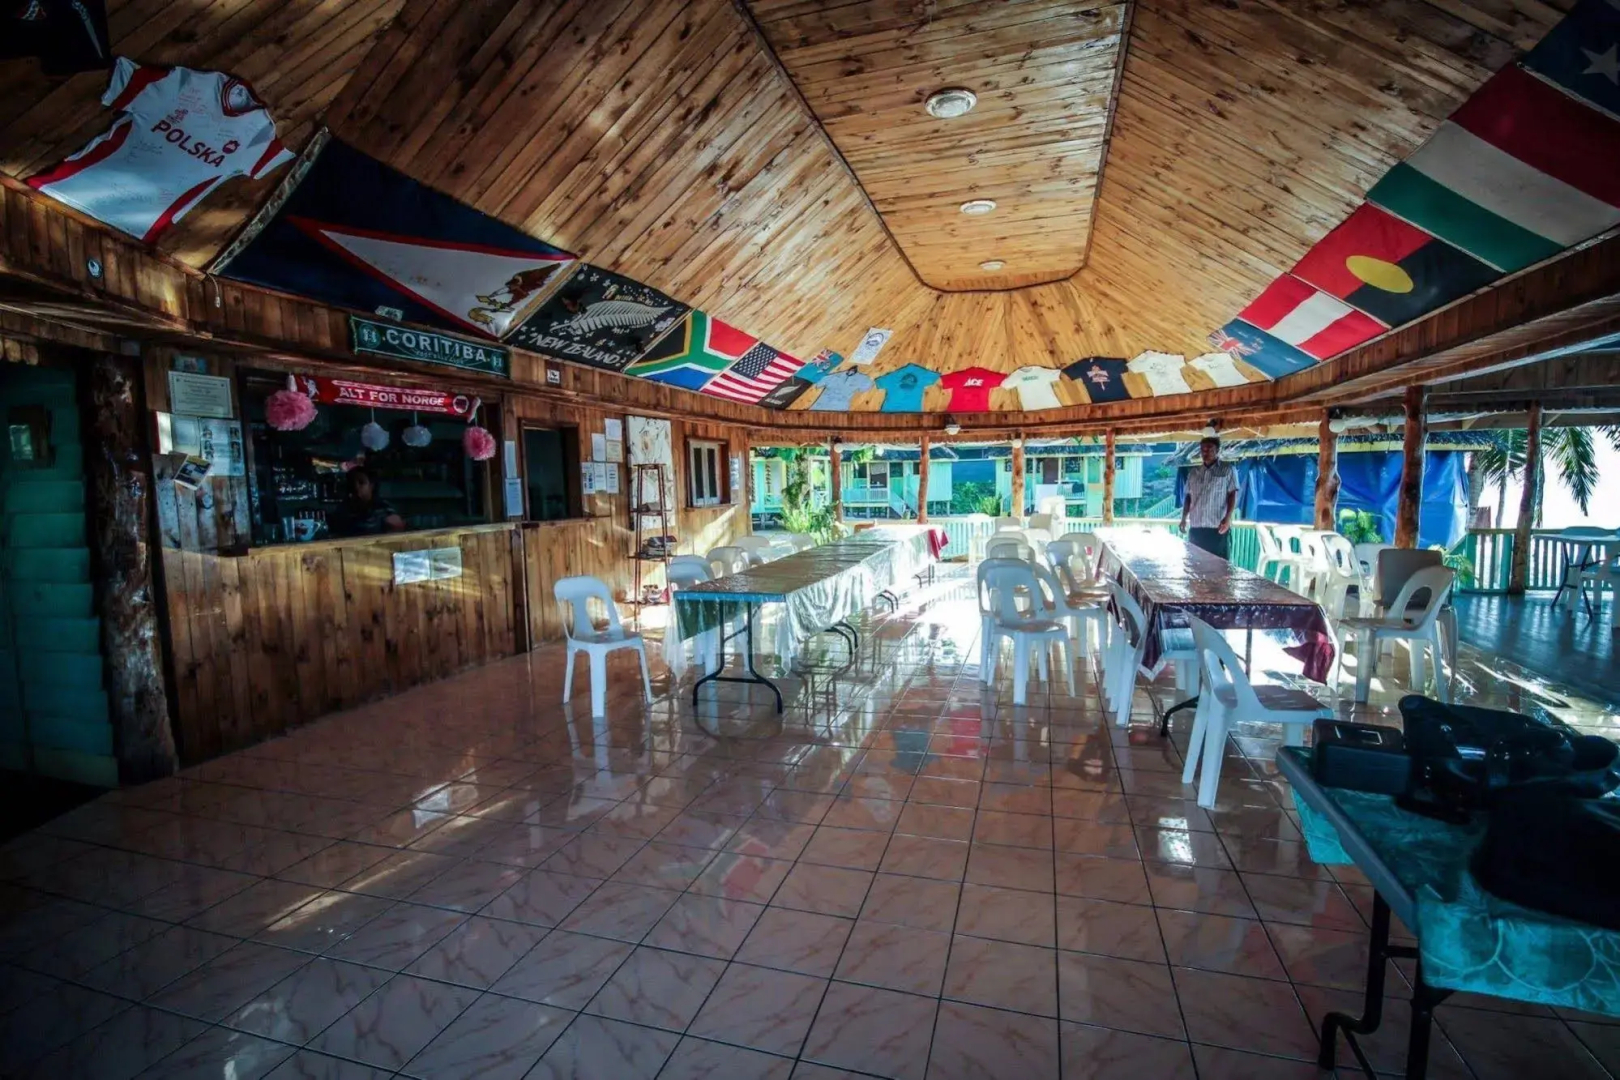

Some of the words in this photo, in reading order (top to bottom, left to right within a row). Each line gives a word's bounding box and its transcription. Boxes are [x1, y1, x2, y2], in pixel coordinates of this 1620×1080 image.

[150, 119, 226, 168] POLSKA
[385, 329, 488, 363] CORITIBA
[529, 334, 570, 351] NEW
[563, 342, 622, 365] ZEALAND
[339, 387, 365, 399] ALT
[369, 391, 398, 404] FOR
[402, 394, 445, 406] NORGE
[963, 377, 984, 387] ACE
